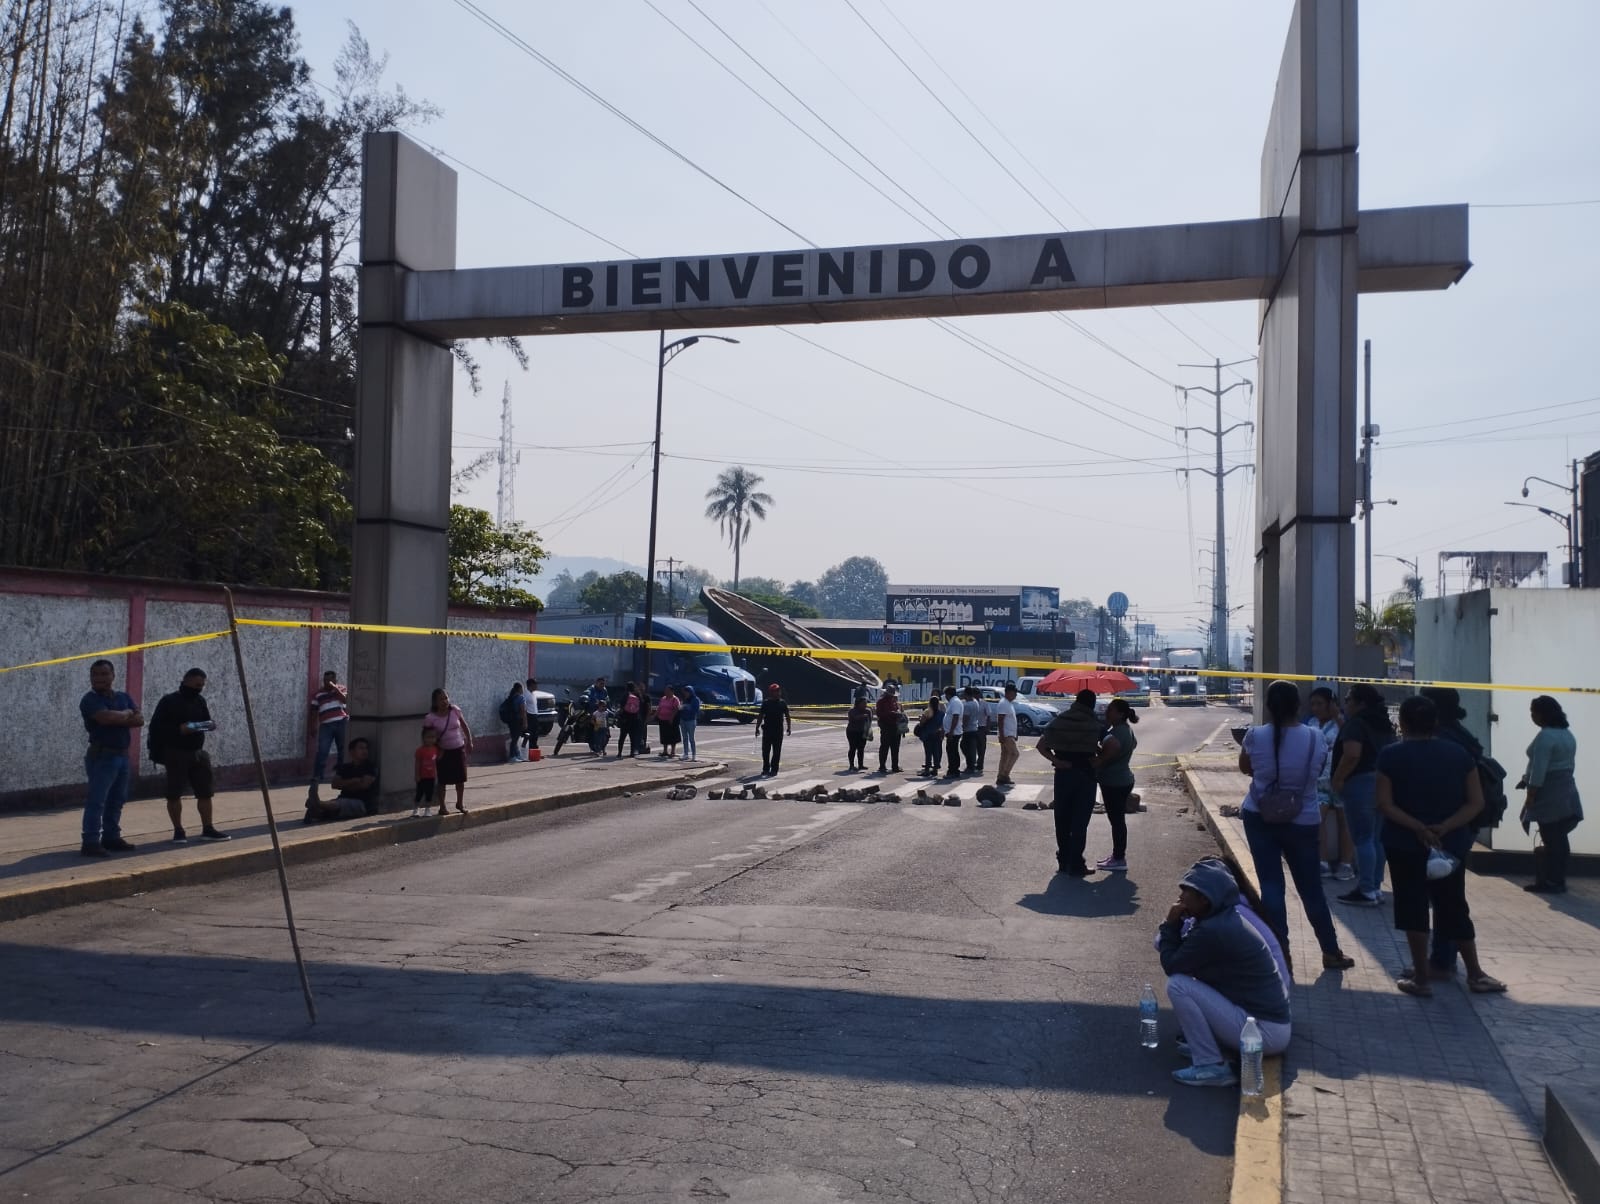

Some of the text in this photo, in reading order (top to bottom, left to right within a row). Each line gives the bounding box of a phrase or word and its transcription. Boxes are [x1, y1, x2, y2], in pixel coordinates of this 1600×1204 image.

[561, 238, 1077, 309] BIENVENIDO A
[984, 607, 1010, 616] Mobil
[869, 630, 976, 646] Mobil Delvac
